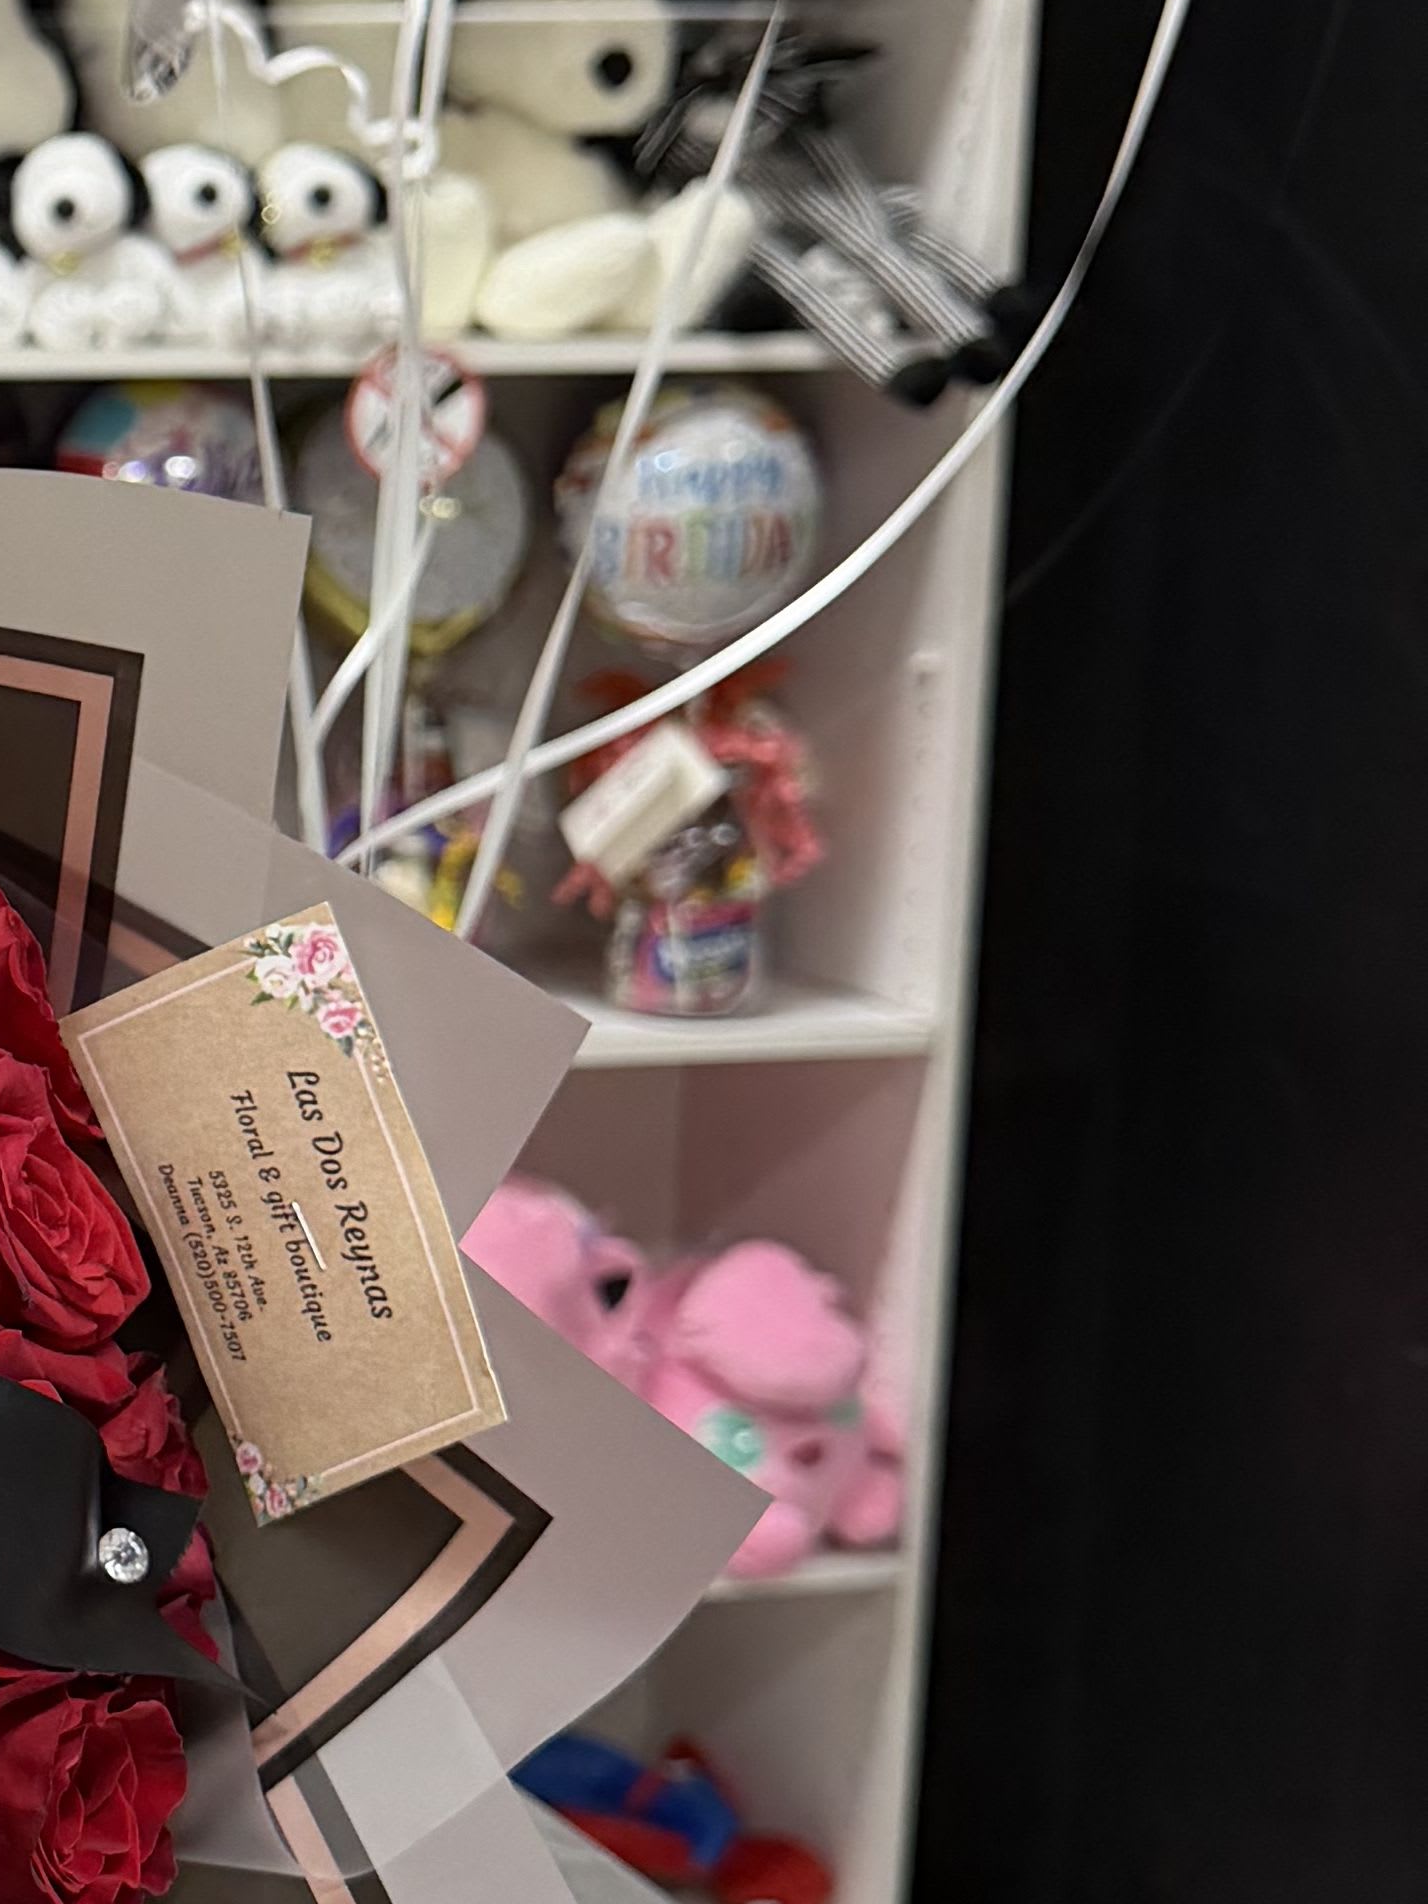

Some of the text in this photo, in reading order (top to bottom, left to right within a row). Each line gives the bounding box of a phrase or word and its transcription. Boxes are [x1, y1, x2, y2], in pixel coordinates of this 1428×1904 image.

[157, 1162, 192, 1227] Deanna
[186, 1176, 218, 1241] Tucson,
[207, 1169, 239, 1211] 5325
[233, 1234, 259, 1272] 12th
[229, 1089, 334, 1343] Floral & gift boutique
[286, 1069, 394, 1322] Las Dos Reynas
